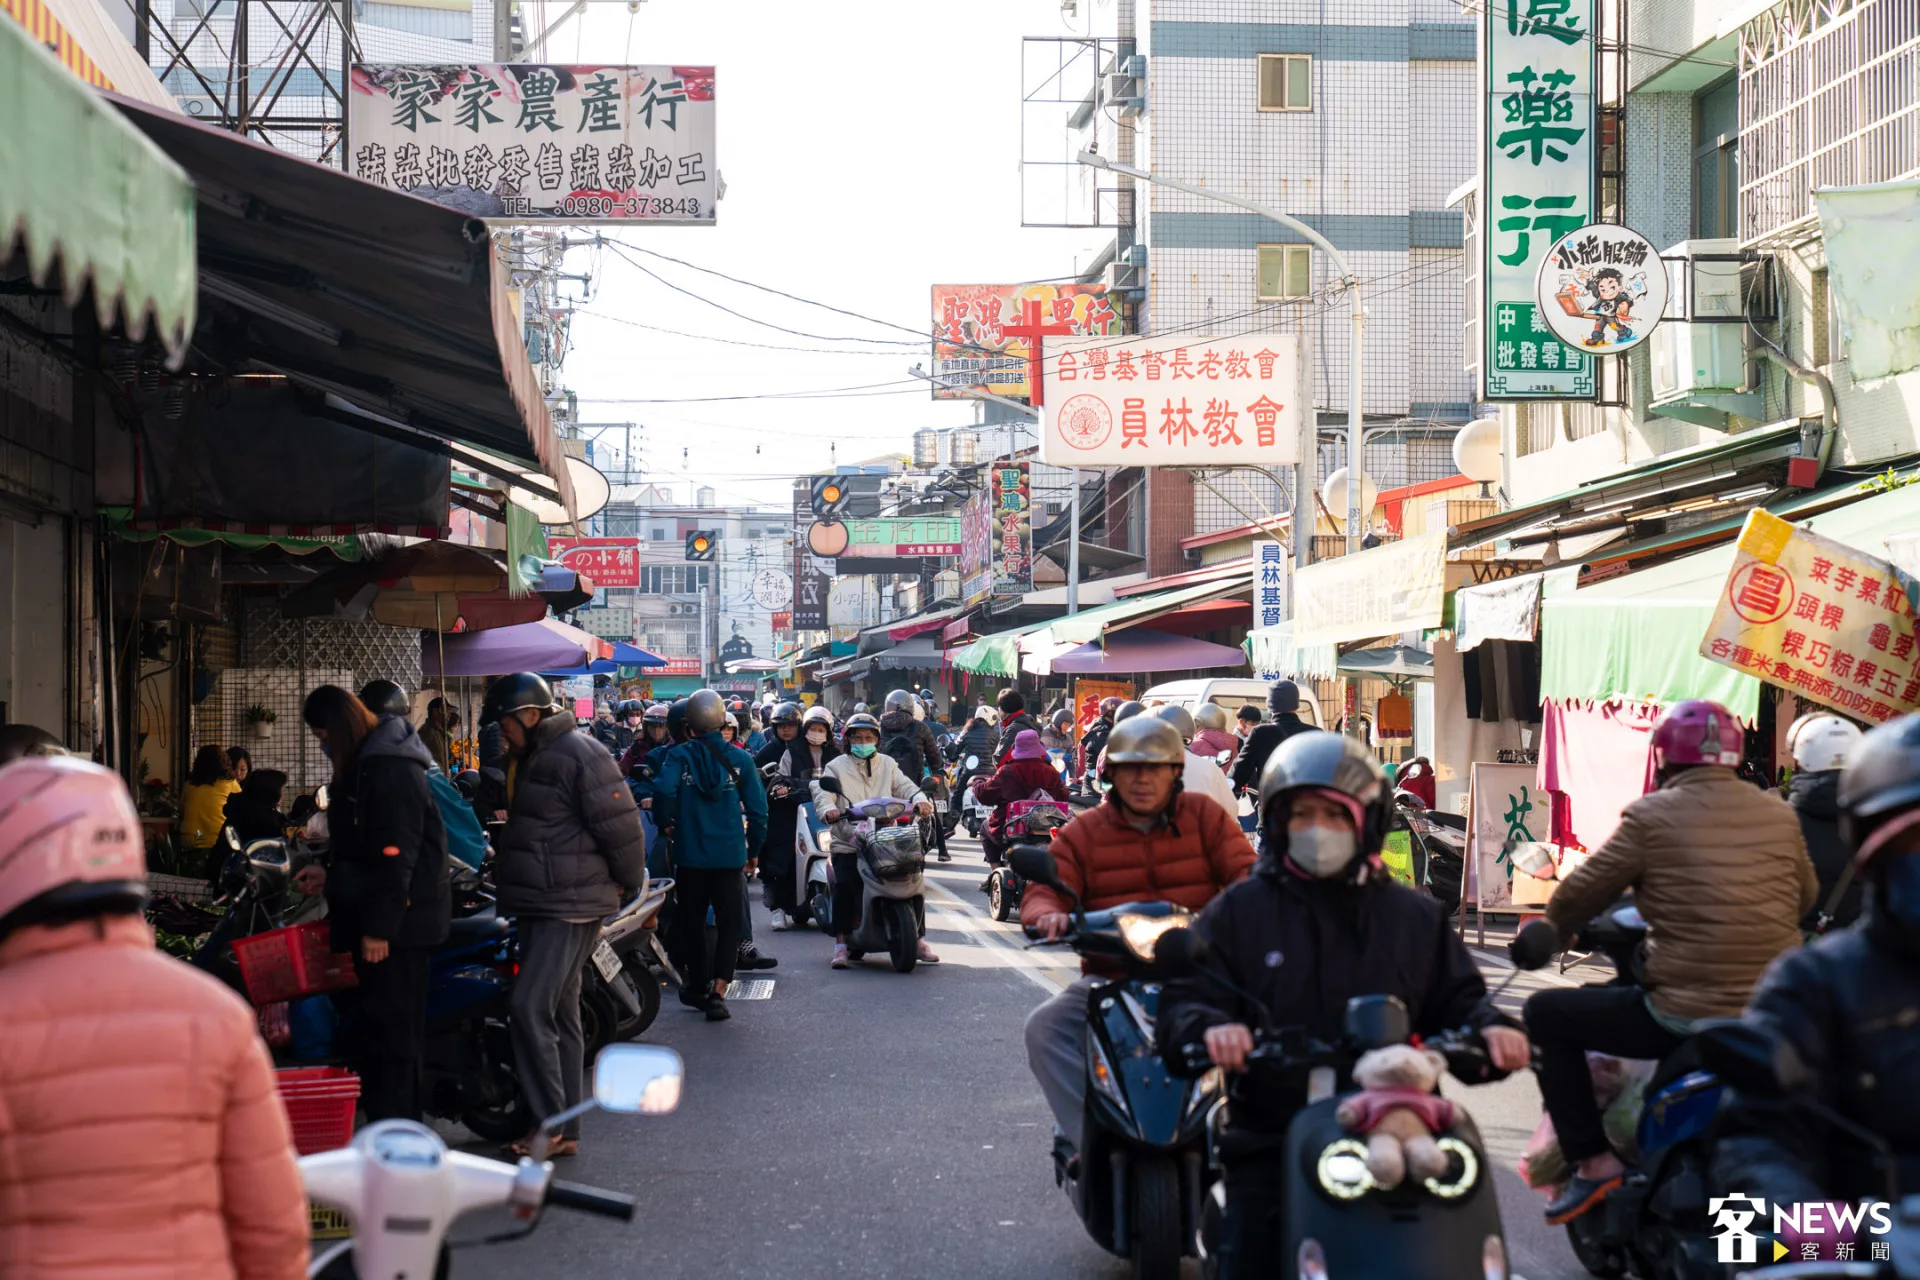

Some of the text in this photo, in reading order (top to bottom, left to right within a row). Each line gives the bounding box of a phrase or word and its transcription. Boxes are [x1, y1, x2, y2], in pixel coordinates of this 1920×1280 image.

[390, 72, 689, 133] 家家農產行
[356, 143, 707, 193] 蔬菜批發零售蔬菜加工
[502, 197, 540, 214] TEL
[1557, 235, 1648, 270] 小施服飾
[1058, 348, 1280, 381] 台灣基督長老教會
[1498, 340, 1581, 369] 批發零售
[1121, 394, 1285, 448] 員林教會
[1001, 470, 1021, 573] 聖鴻水果行
[908, 545, 953, 554] 水果專賣店
